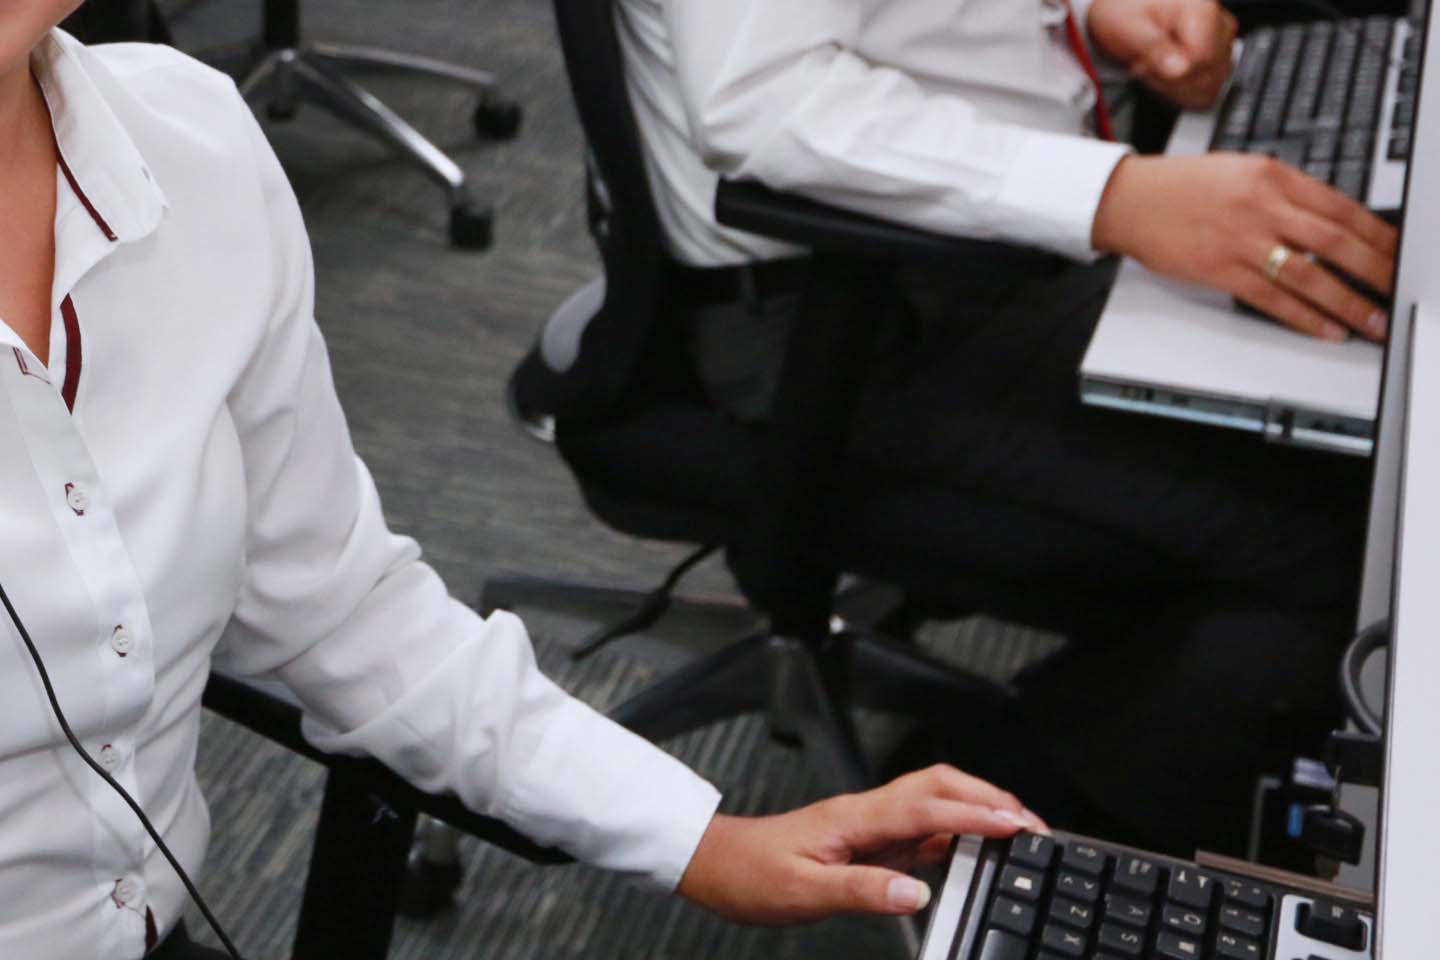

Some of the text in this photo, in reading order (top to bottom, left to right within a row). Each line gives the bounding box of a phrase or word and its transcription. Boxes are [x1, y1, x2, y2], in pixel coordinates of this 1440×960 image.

[1070, 905, 1088, 918] Z
[1128, 905, 1144, 916] A
[1120, 932, 1138, 943] S
